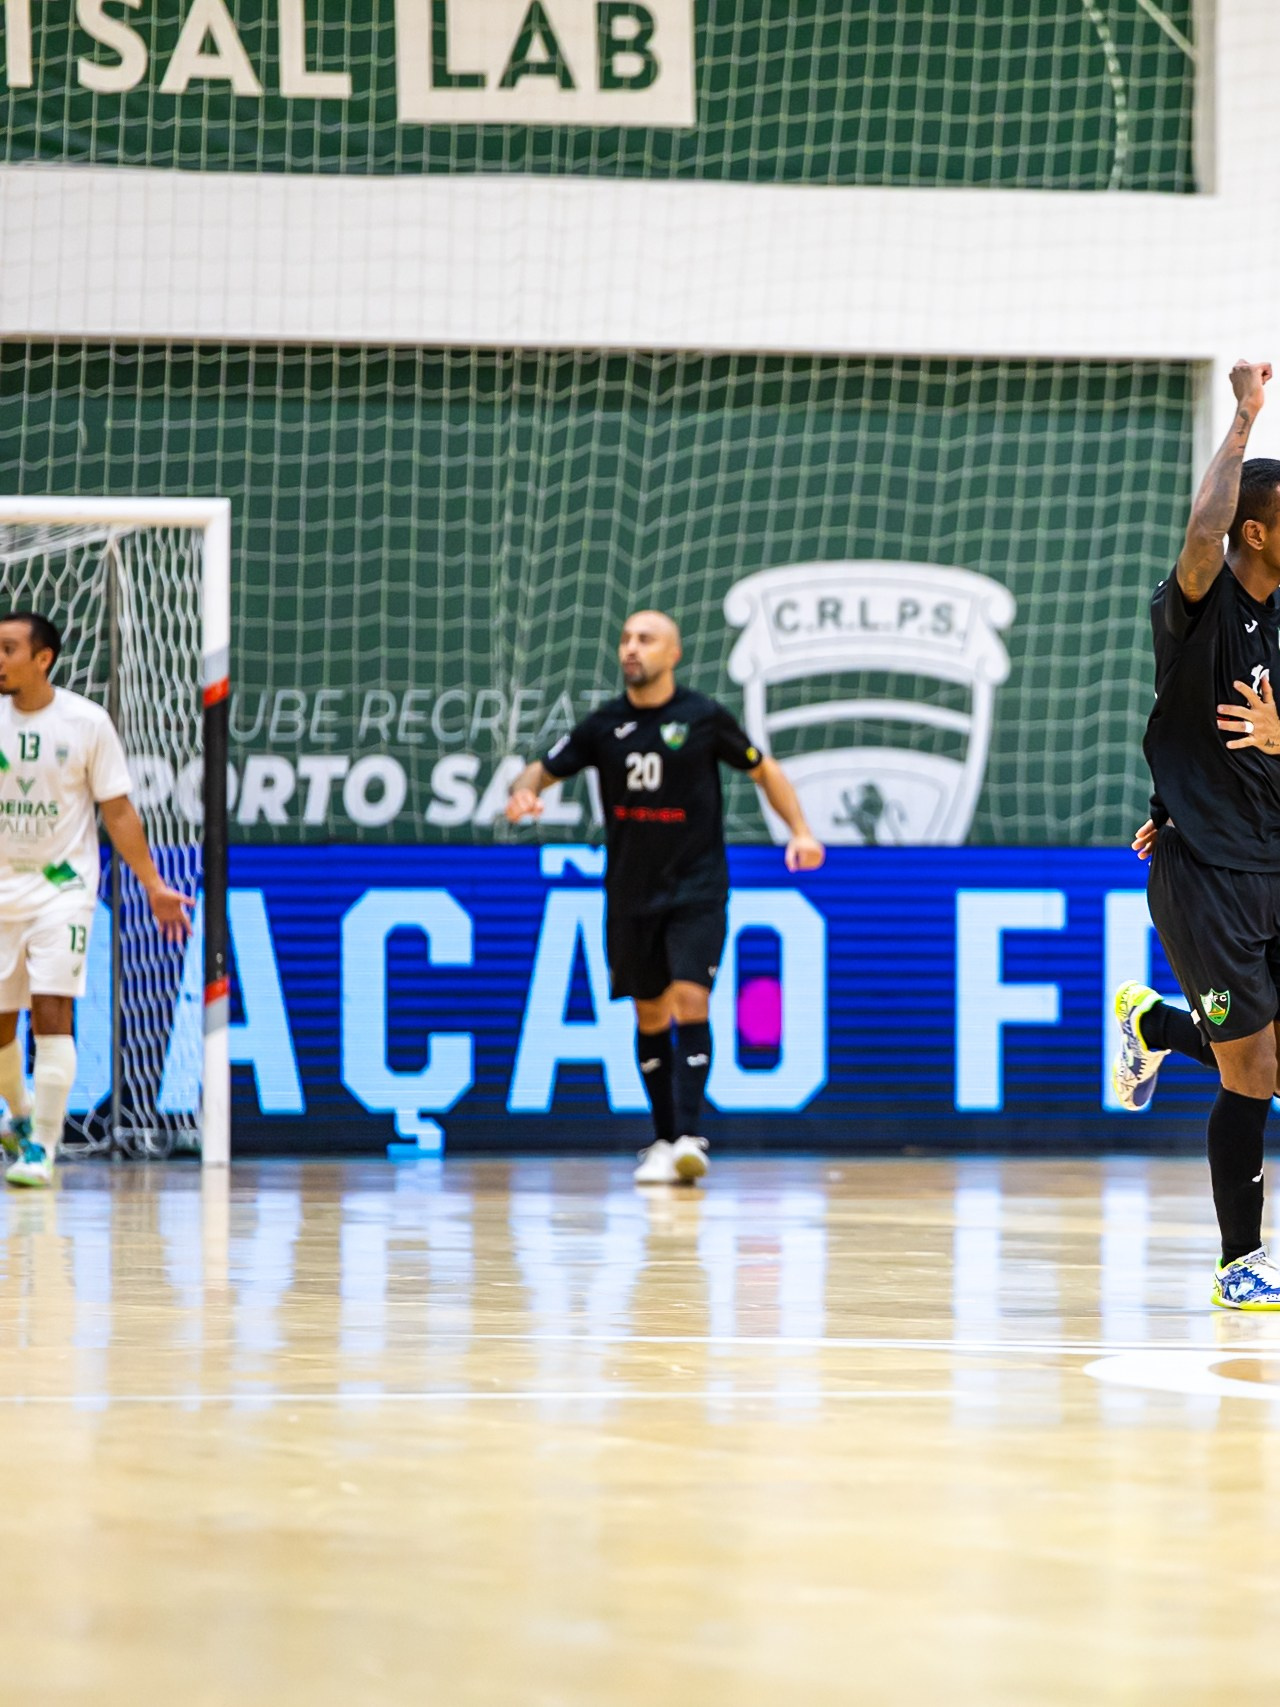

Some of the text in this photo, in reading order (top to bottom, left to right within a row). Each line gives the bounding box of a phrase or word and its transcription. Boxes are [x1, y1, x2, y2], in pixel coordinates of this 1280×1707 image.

[429, 0, 660, 92] LAB
[163, 688, 612, 743] UBE RECREAT
[18, 732, 41, 763] 13
[425, 754, 604, 827] SAL
[625, 751, 662, 791] 20
[0, 819, 57, 838] ALLEY
[69, 924, 87, 953] 13
